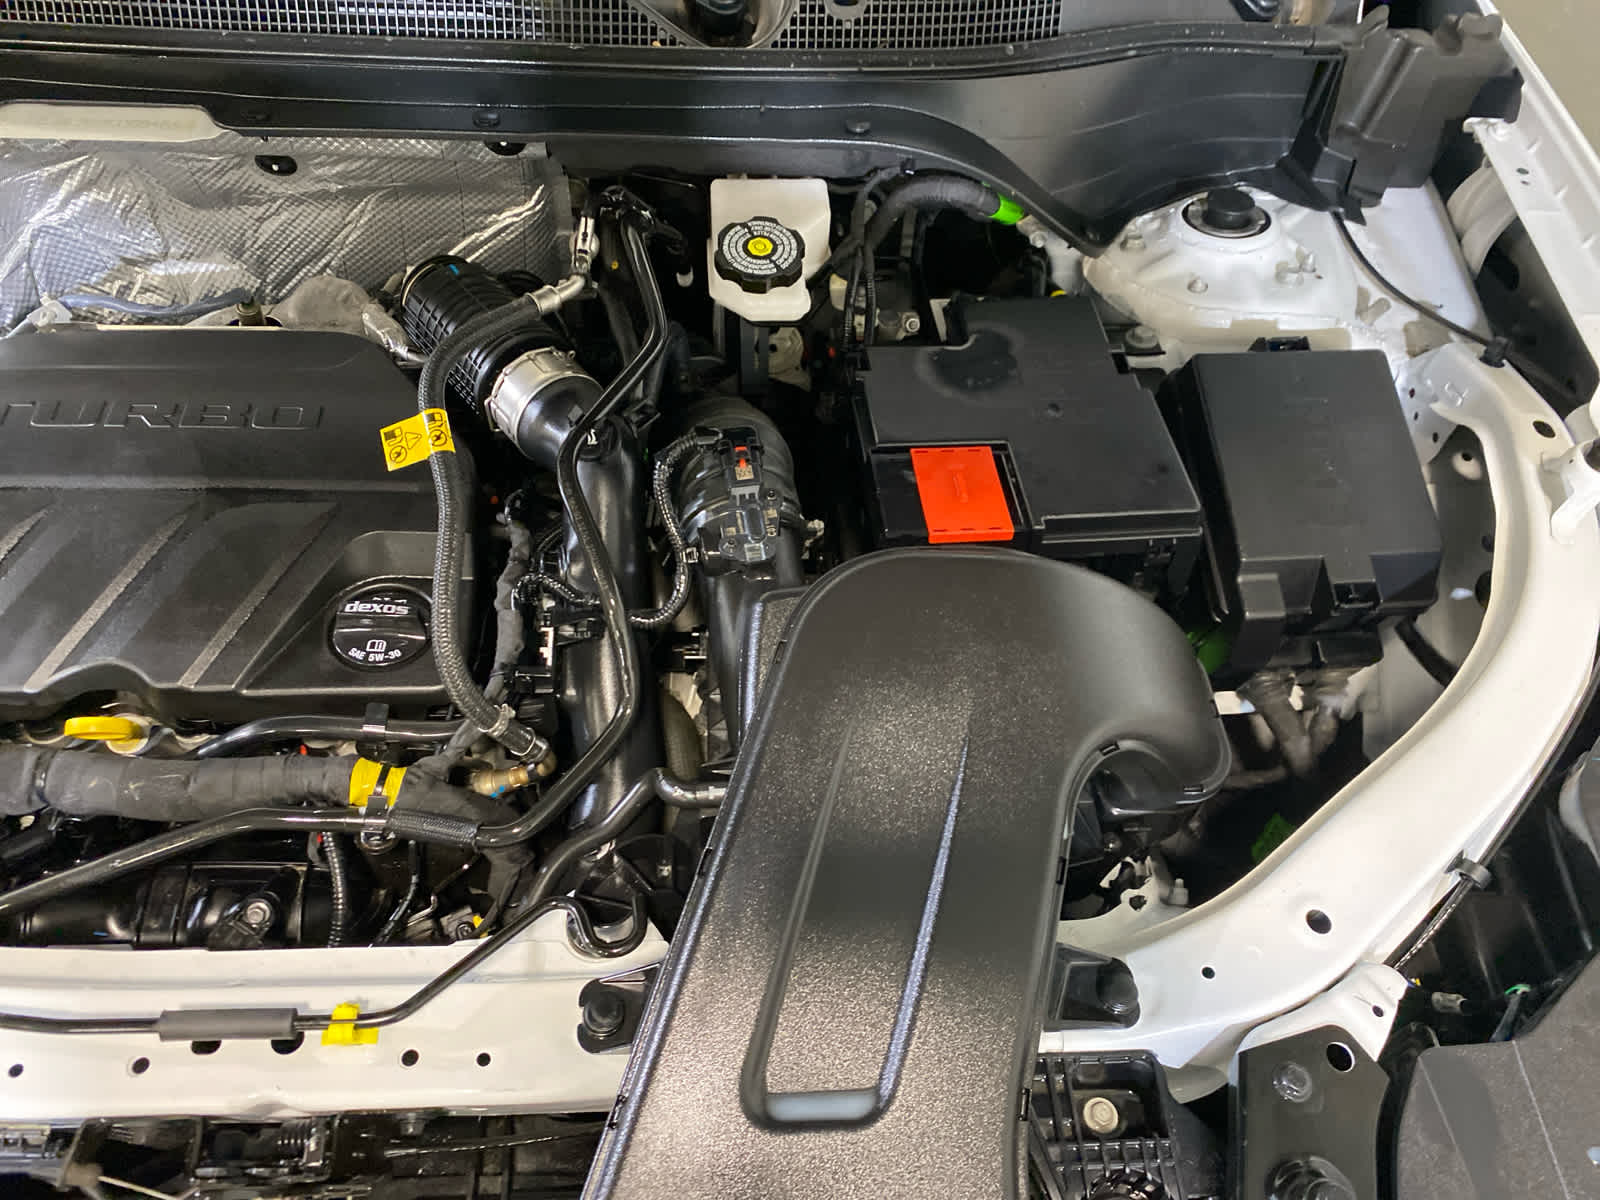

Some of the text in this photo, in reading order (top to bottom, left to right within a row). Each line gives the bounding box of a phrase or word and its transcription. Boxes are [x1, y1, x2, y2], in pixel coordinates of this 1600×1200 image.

[344, 600, 409, 615] dexos
[348, 647, 402, 662] SAE 5W-30
